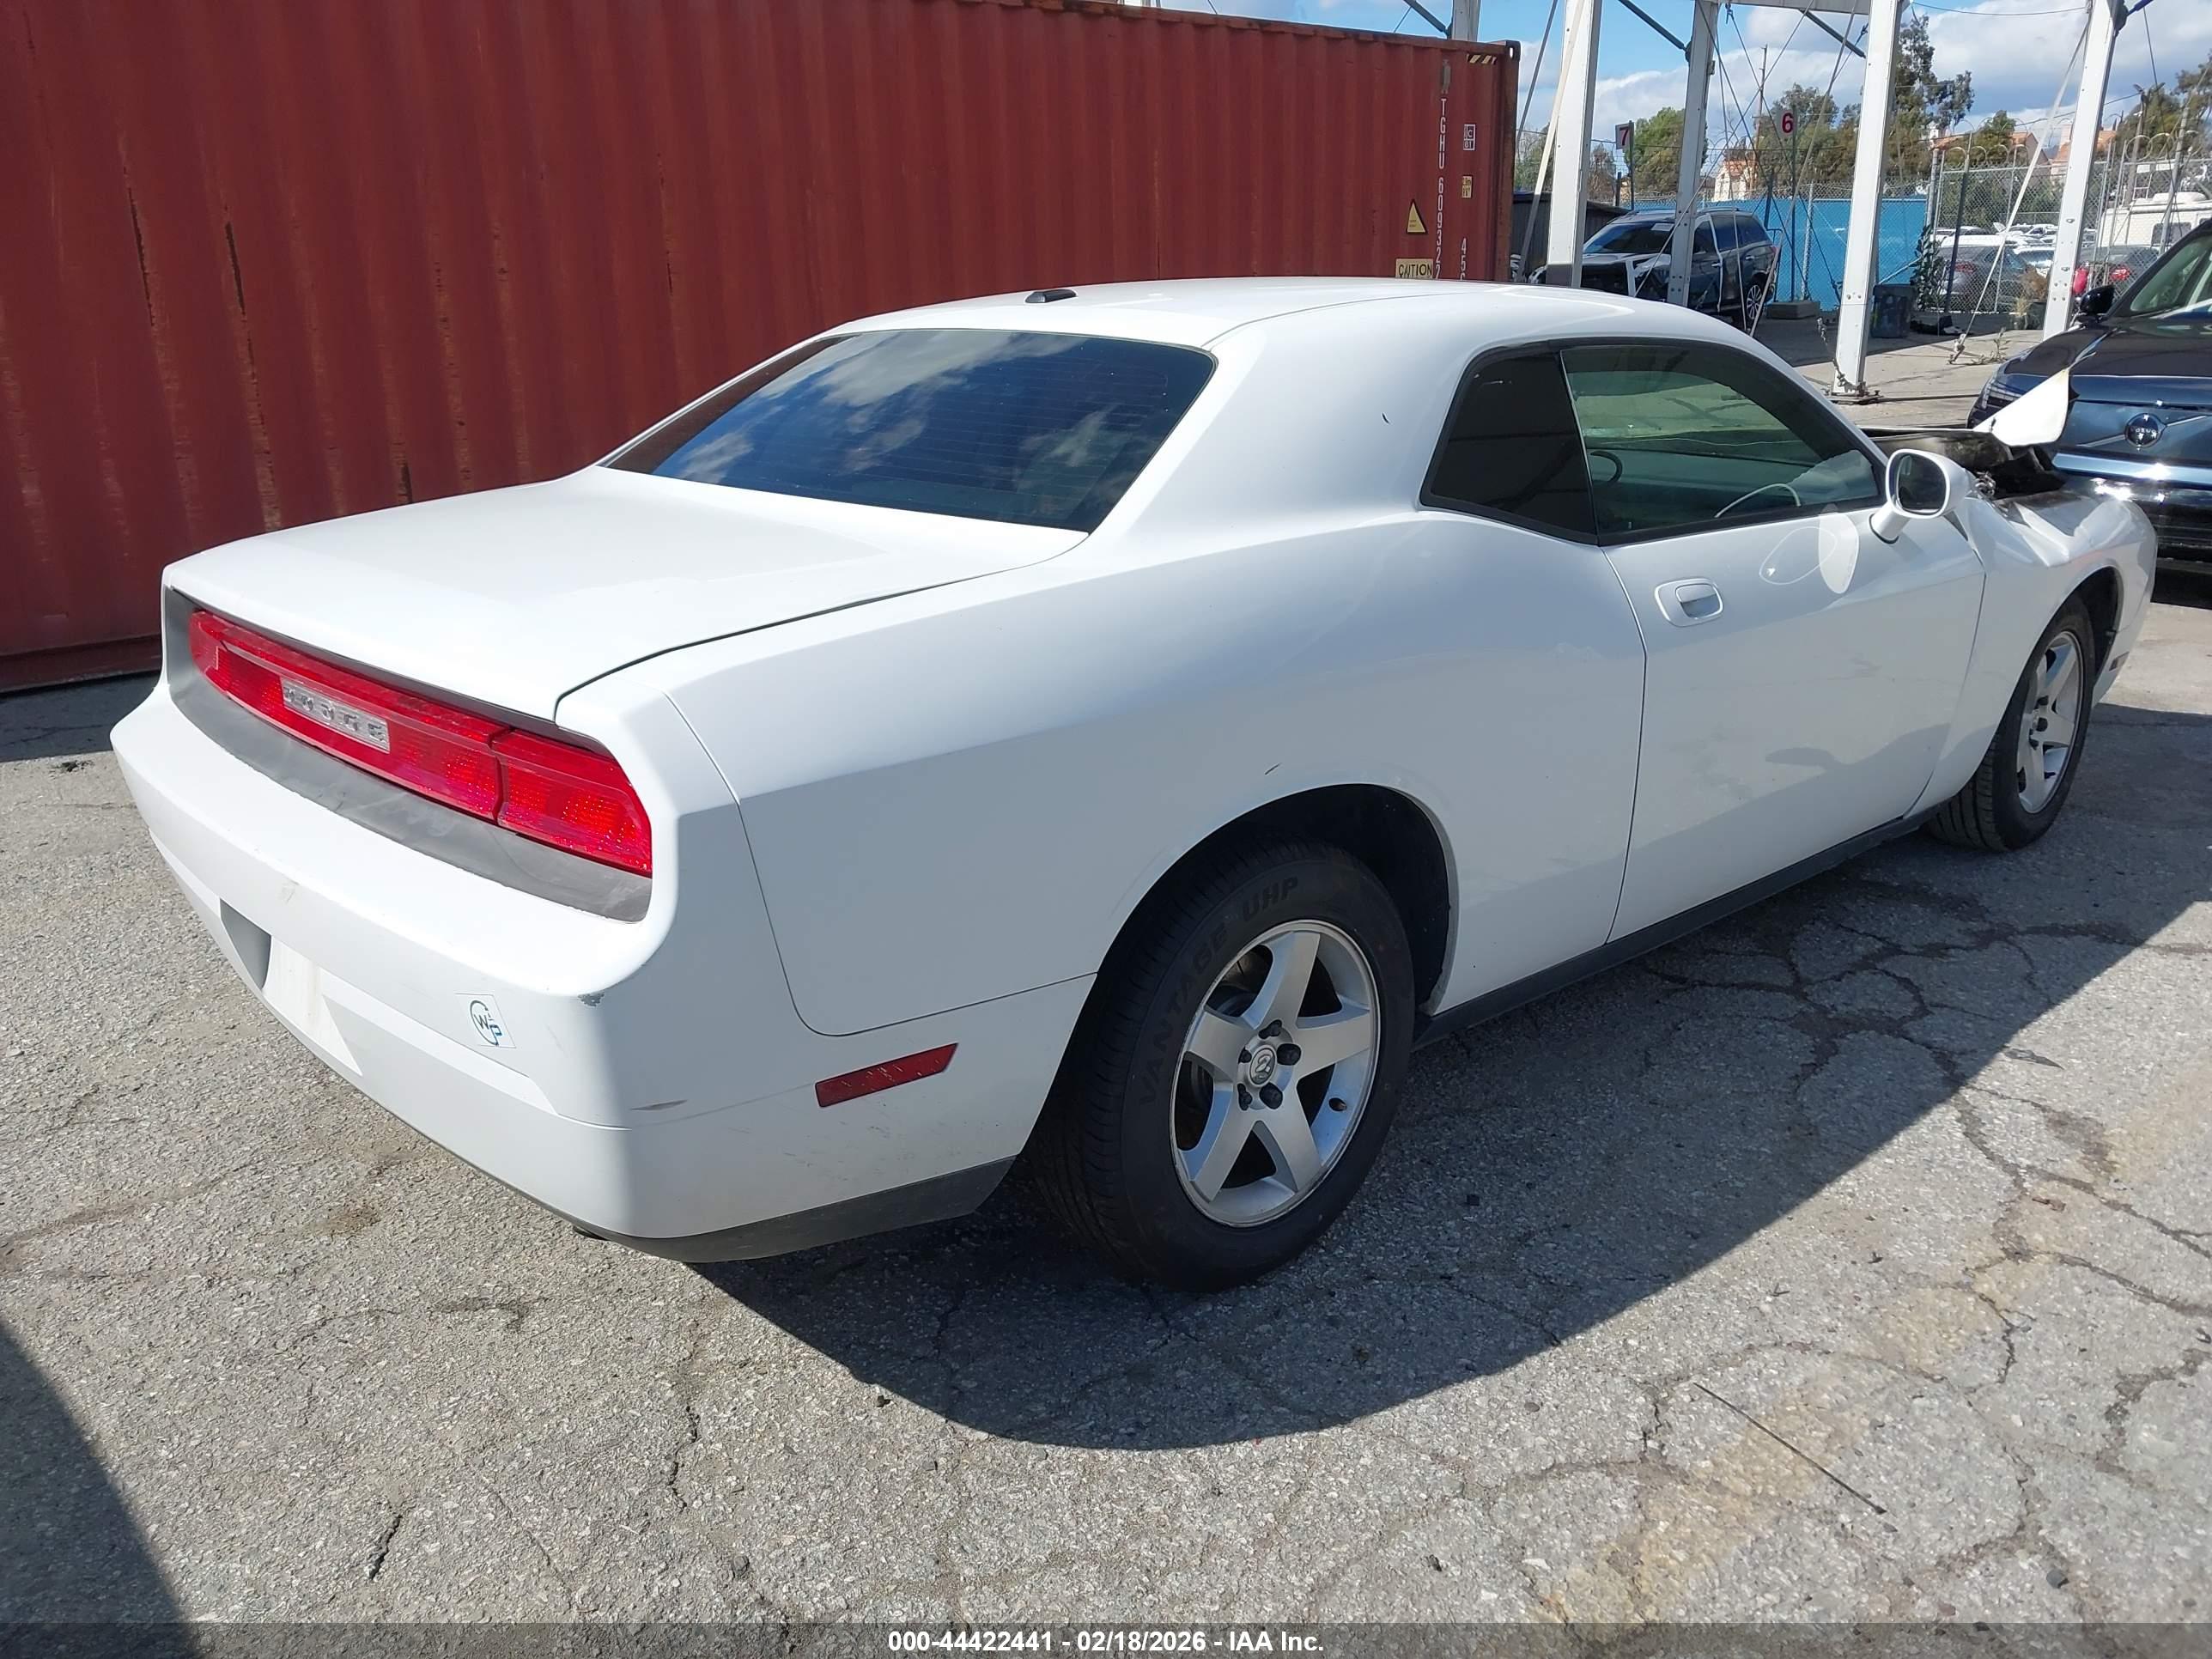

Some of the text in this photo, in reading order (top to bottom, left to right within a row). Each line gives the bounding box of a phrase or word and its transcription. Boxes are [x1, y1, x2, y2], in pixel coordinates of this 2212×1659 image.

[1619, 126, 1630, 146] 7
[1781, 112, 1795, 134] 6
[1434, 176, 1444, 280] 609322
[1140, 876, 1299, 1105] VANTAGE UHP
